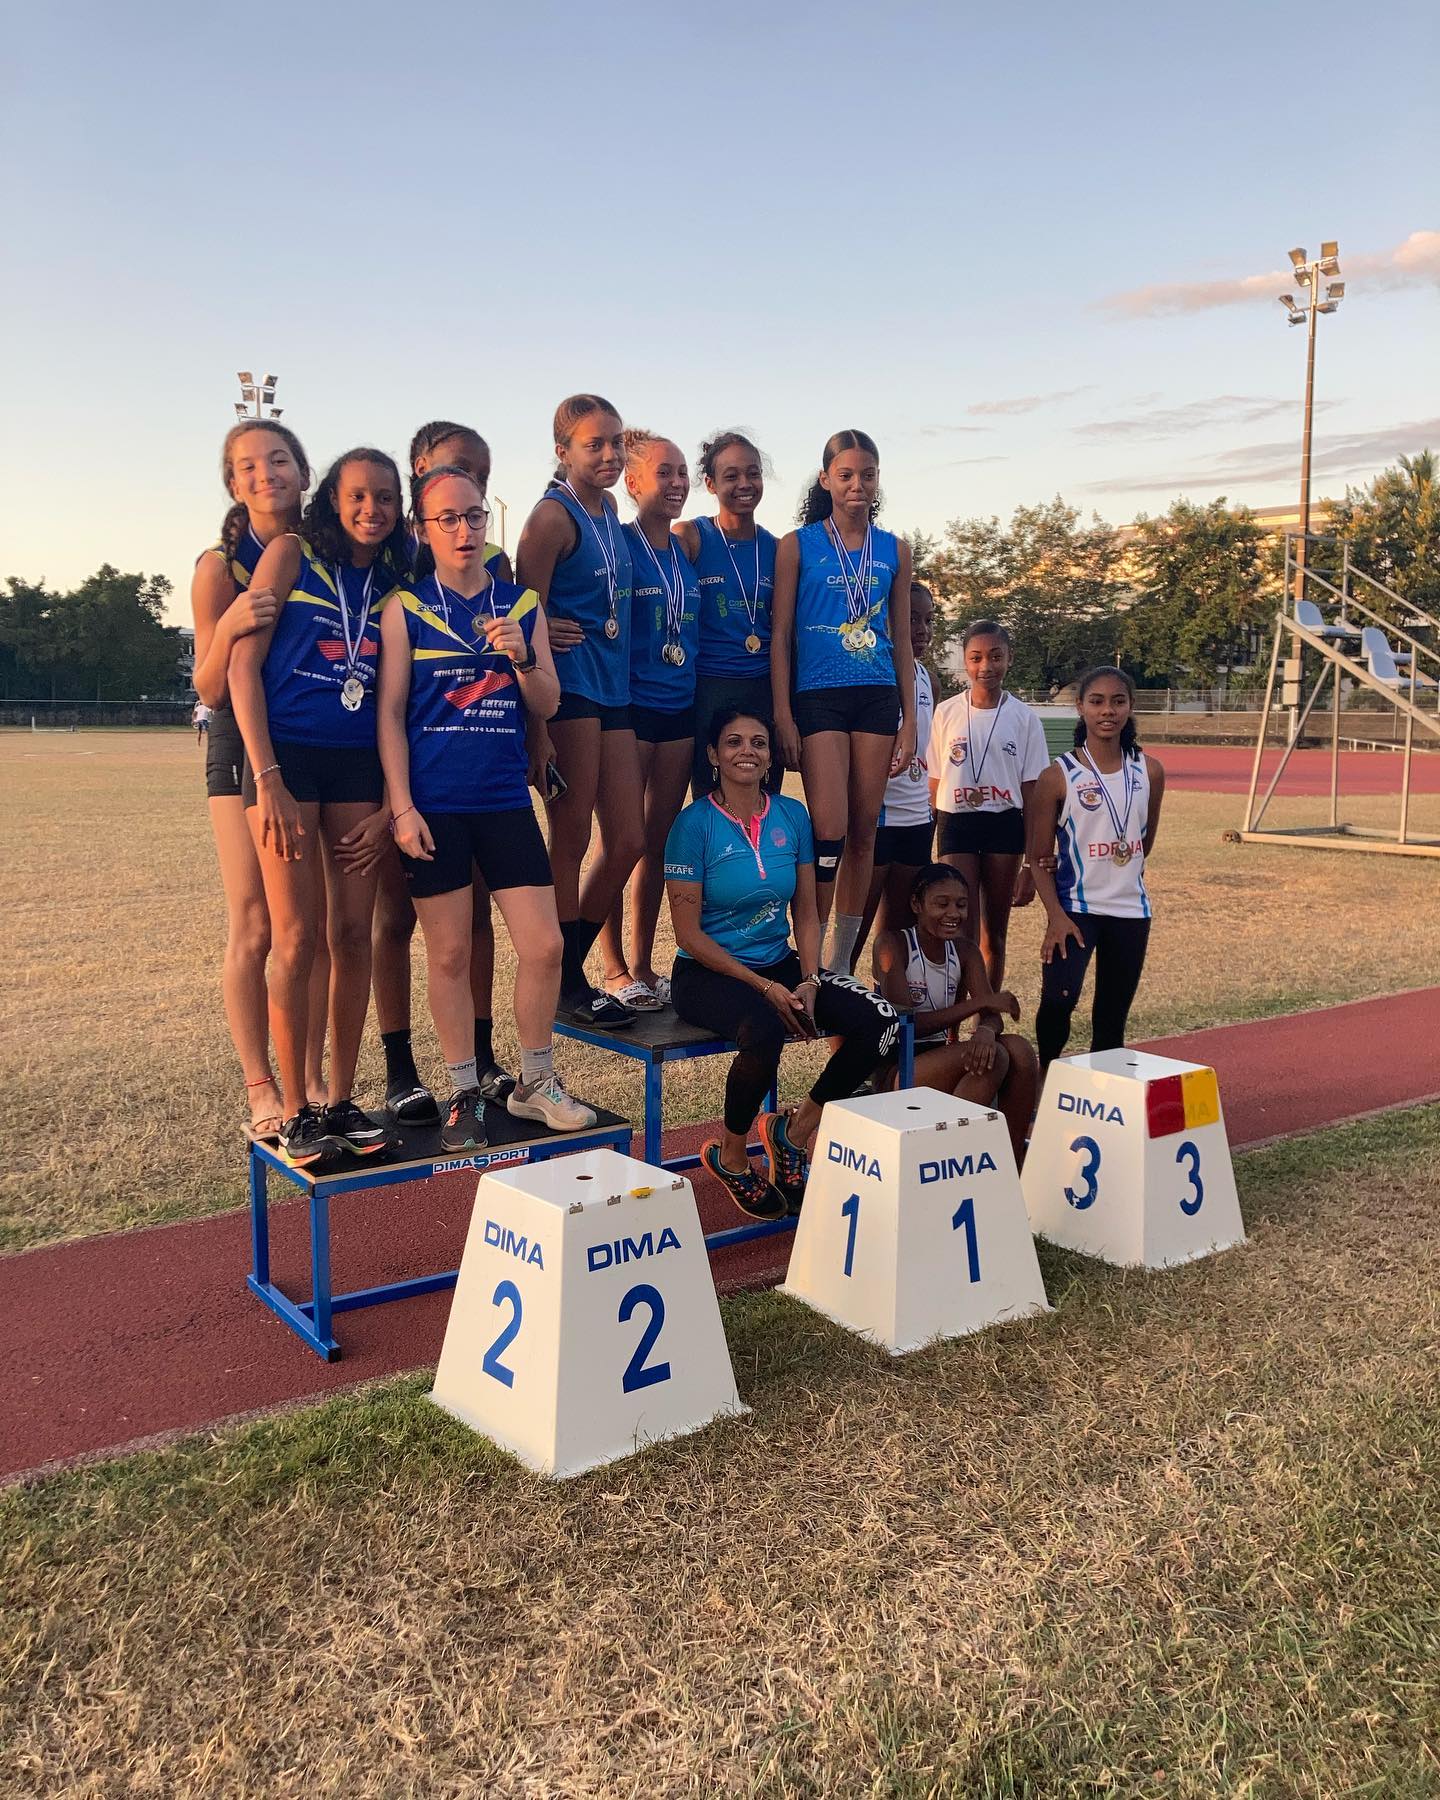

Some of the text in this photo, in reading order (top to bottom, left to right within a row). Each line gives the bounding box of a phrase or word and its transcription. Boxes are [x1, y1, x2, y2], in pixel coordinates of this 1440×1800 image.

[1057, 1092, 1126, 1127] DIMA
[828, 1140, 883, 1183] DIMA
[919, 1152, 998, 1185] DIMA
[1064, 1135, 1102, 1210] 3
[1176, 1141, 1204, 1217] 3
[484, 1219, 545, 1272] DIMA
[587, 1227, 682, 1273] DIMA
[841, 1193, 861, 1278] 1
[952, 1198, 981, 1284] 1
[482, 1280, 522, 1390] 2
[618, 1284, 671, 1394] 2
